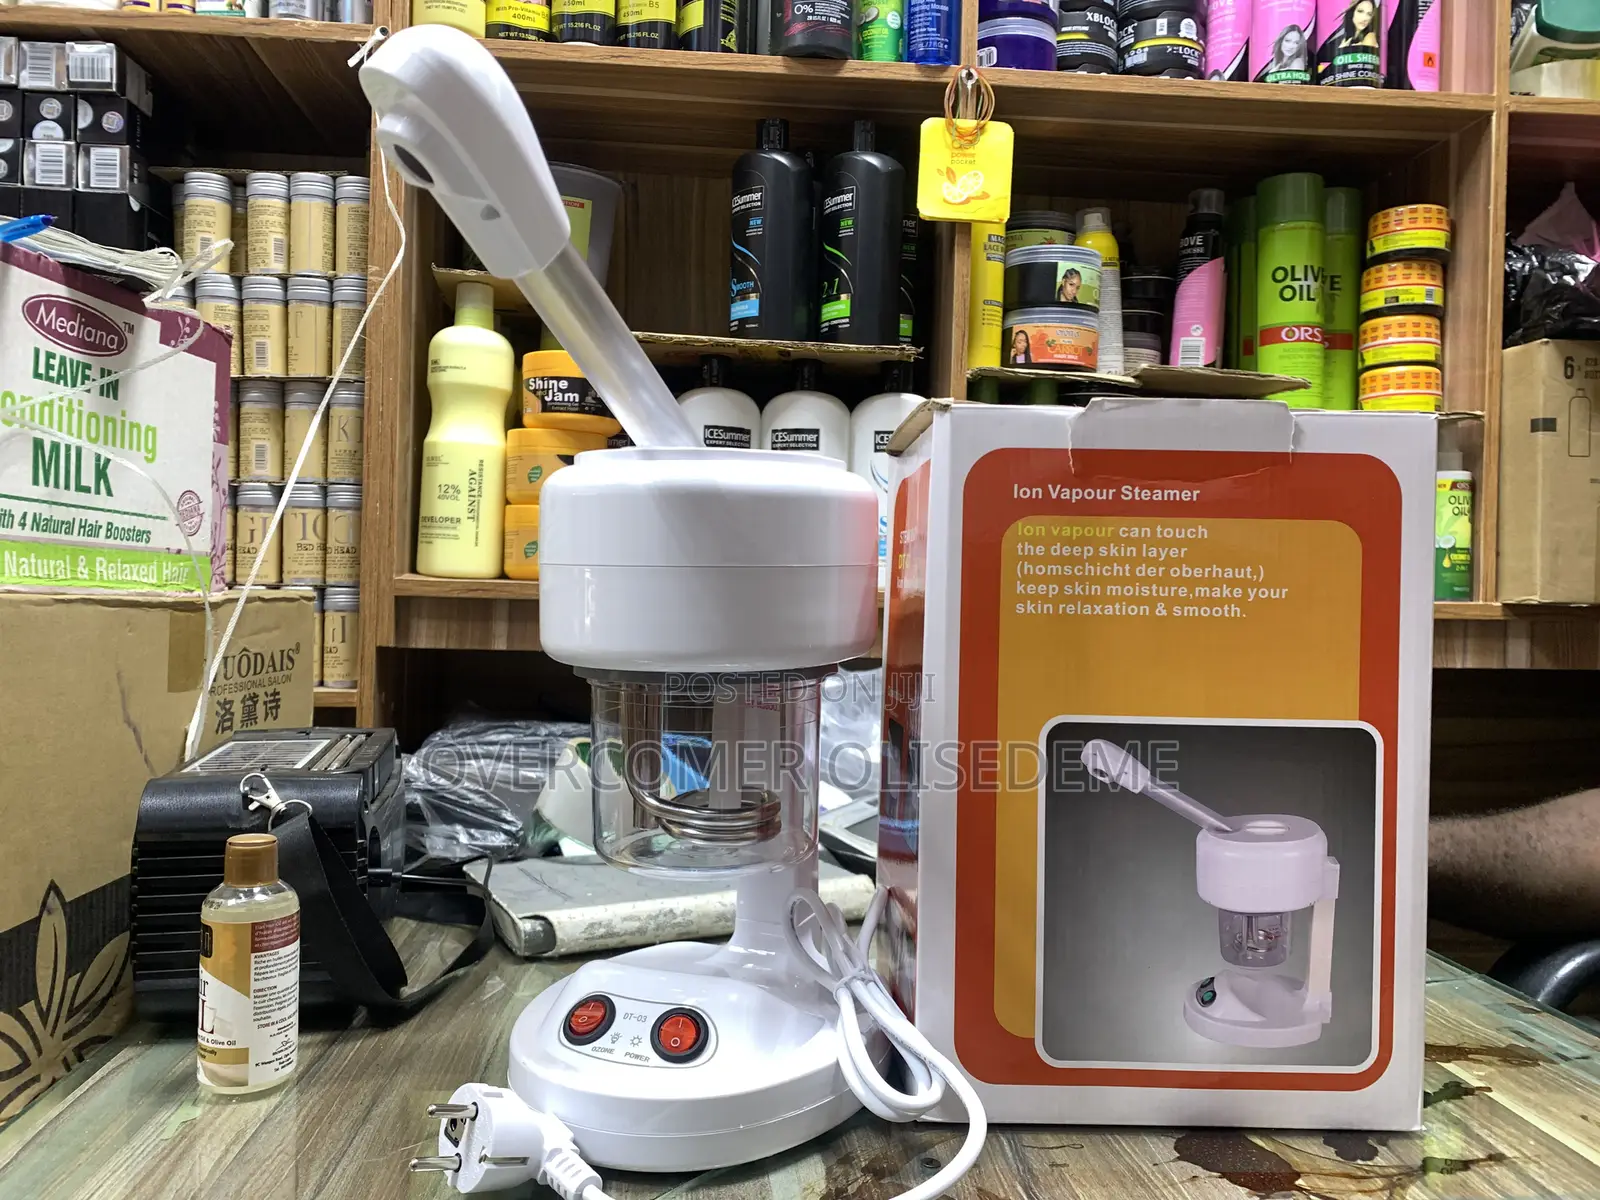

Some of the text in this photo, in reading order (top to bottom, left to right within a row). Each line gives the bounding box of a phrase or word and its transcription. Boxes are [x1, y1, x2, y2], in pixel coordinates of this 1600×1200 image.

[512, 12, 536, 23] 400ml
[1336, 54, 1353, 65] OIL
[1335, 71, 1356, 82] SHINE
[1279, 285, 1316, 302] OIL
[35, 302, 119, 350] Mediana
[1281, 326, 1323, 342] ORS
[1564, 355, 1575, 380] 6
[528, 377, 569, 393] Shine
[544, 389, 580, 402] Jam
[704, 428, 751, 442] ICESummer
[772, 431, 818, 443] ICESummer
[32, 437, 114, 498] MILK
[438, 484, 461, 495] 12%
[467, 468, 478, 523] AGAINST
[1013, 483, 1201, 503] Ion Vapour Steamer
[18, 511, 28, 528] 4
[31, 512, 76, 536] Natural
[77, 518, 104, 539] Hair
[104, 522, 152, 544] Boosters
[420, 515, 462, 525] DEVELOPER
[1017, 522, 1209, 540] Ion vapour can touch
[1017, 542, 1188, 561] the deep skin layer
[4, 550, 190, 583] Natural & Relaxed Hair
[1016, 562, 1265, 582] (homschicht der oberhaut,)
[1016, 581, 1060, 598] keep
[1064, 581, 1102, 596] skin
[1247, 586, 1289, 602] your
[1016, 600, 1247, 618] skin relaxation & smooth.
[267, 673, 292, 687] SALON
[215, 687, 282, 735] 洛黛诗
[622, 1012, 649, 1023] DT-03
[591, 1045, 616, 1055] OZONE
[623, 1051, 651, 1063] POWER
